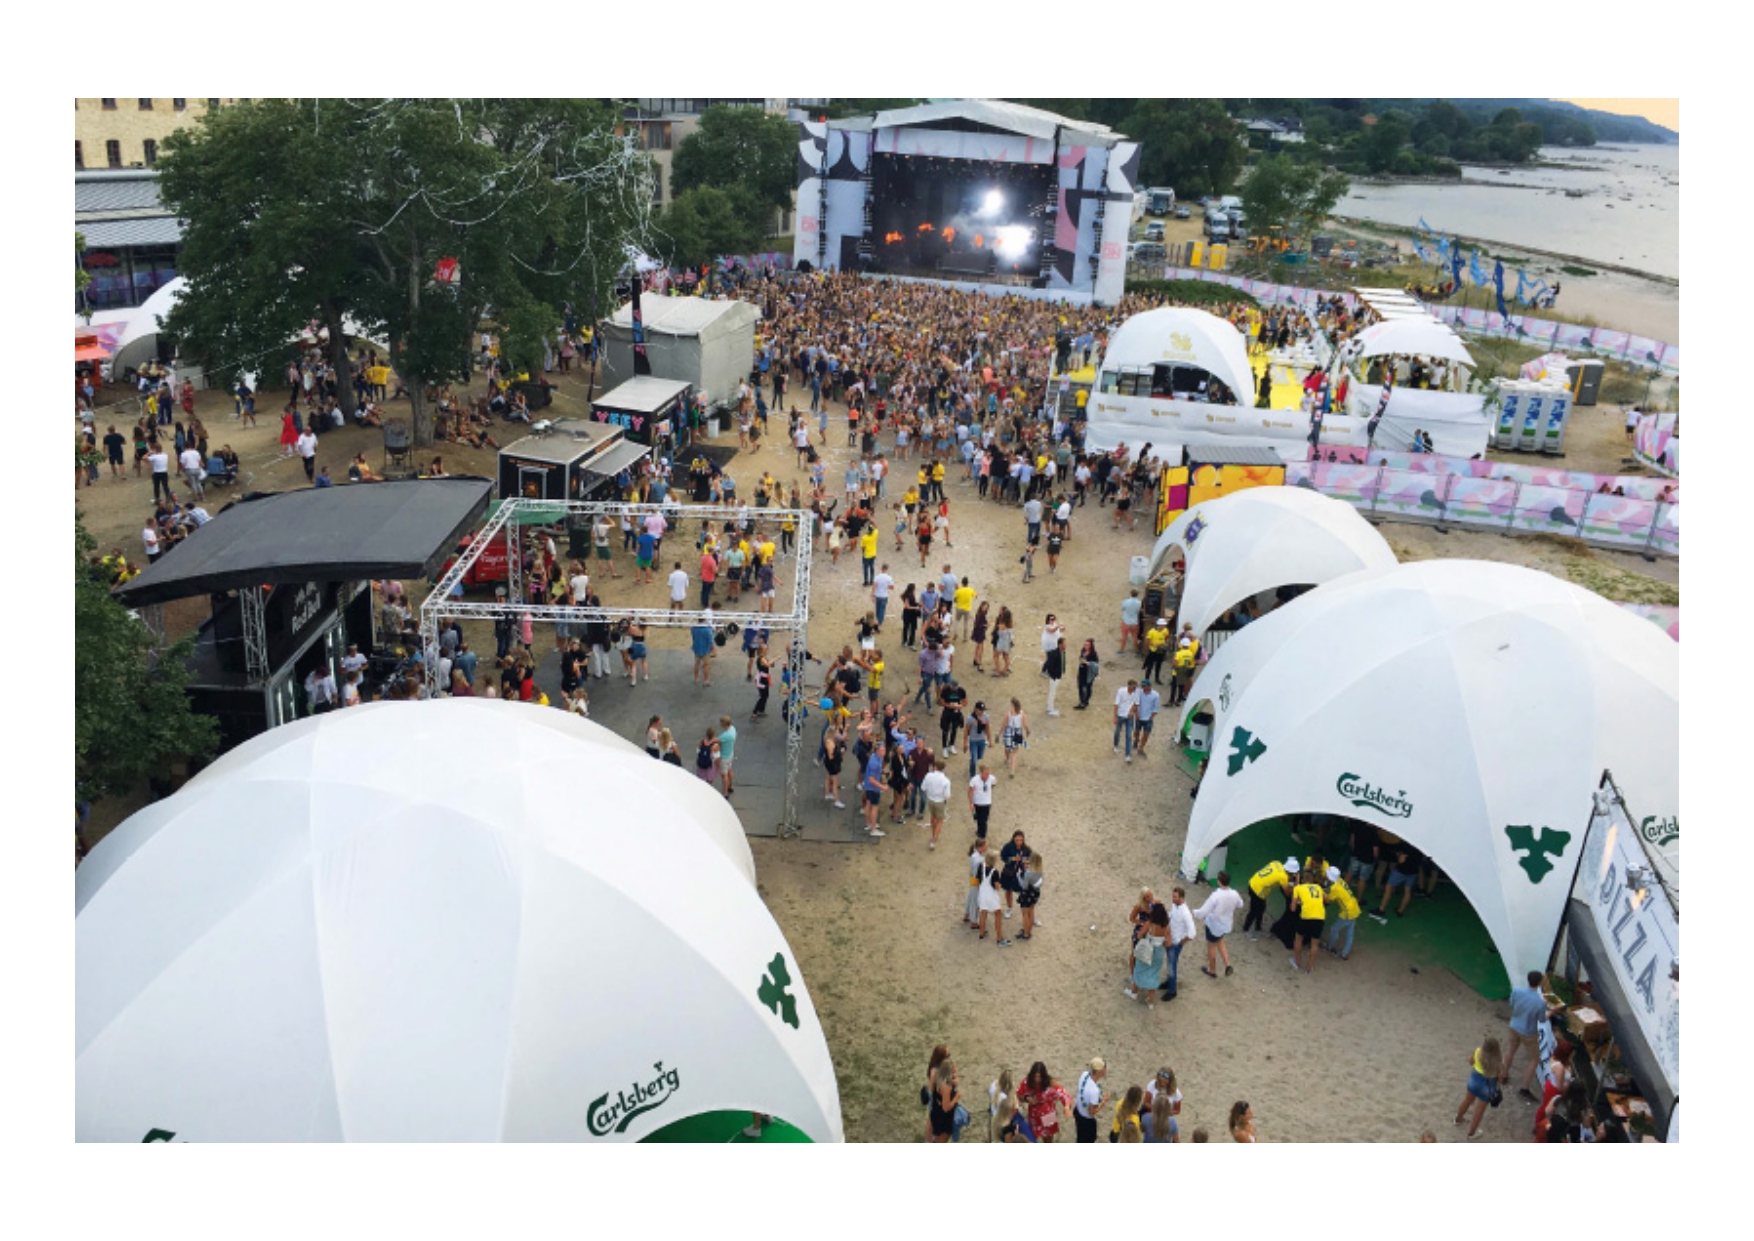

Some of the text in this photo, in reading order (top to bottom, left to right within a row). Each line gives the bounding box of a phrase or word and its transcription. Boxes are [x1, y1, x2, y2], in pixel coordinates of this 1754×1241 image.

[1336, 772, 1413, 818] Carlsberg
[1600, 862, 1657, 1014] PIZZA
[586, 1060, 680, 1137] Carlsberg
